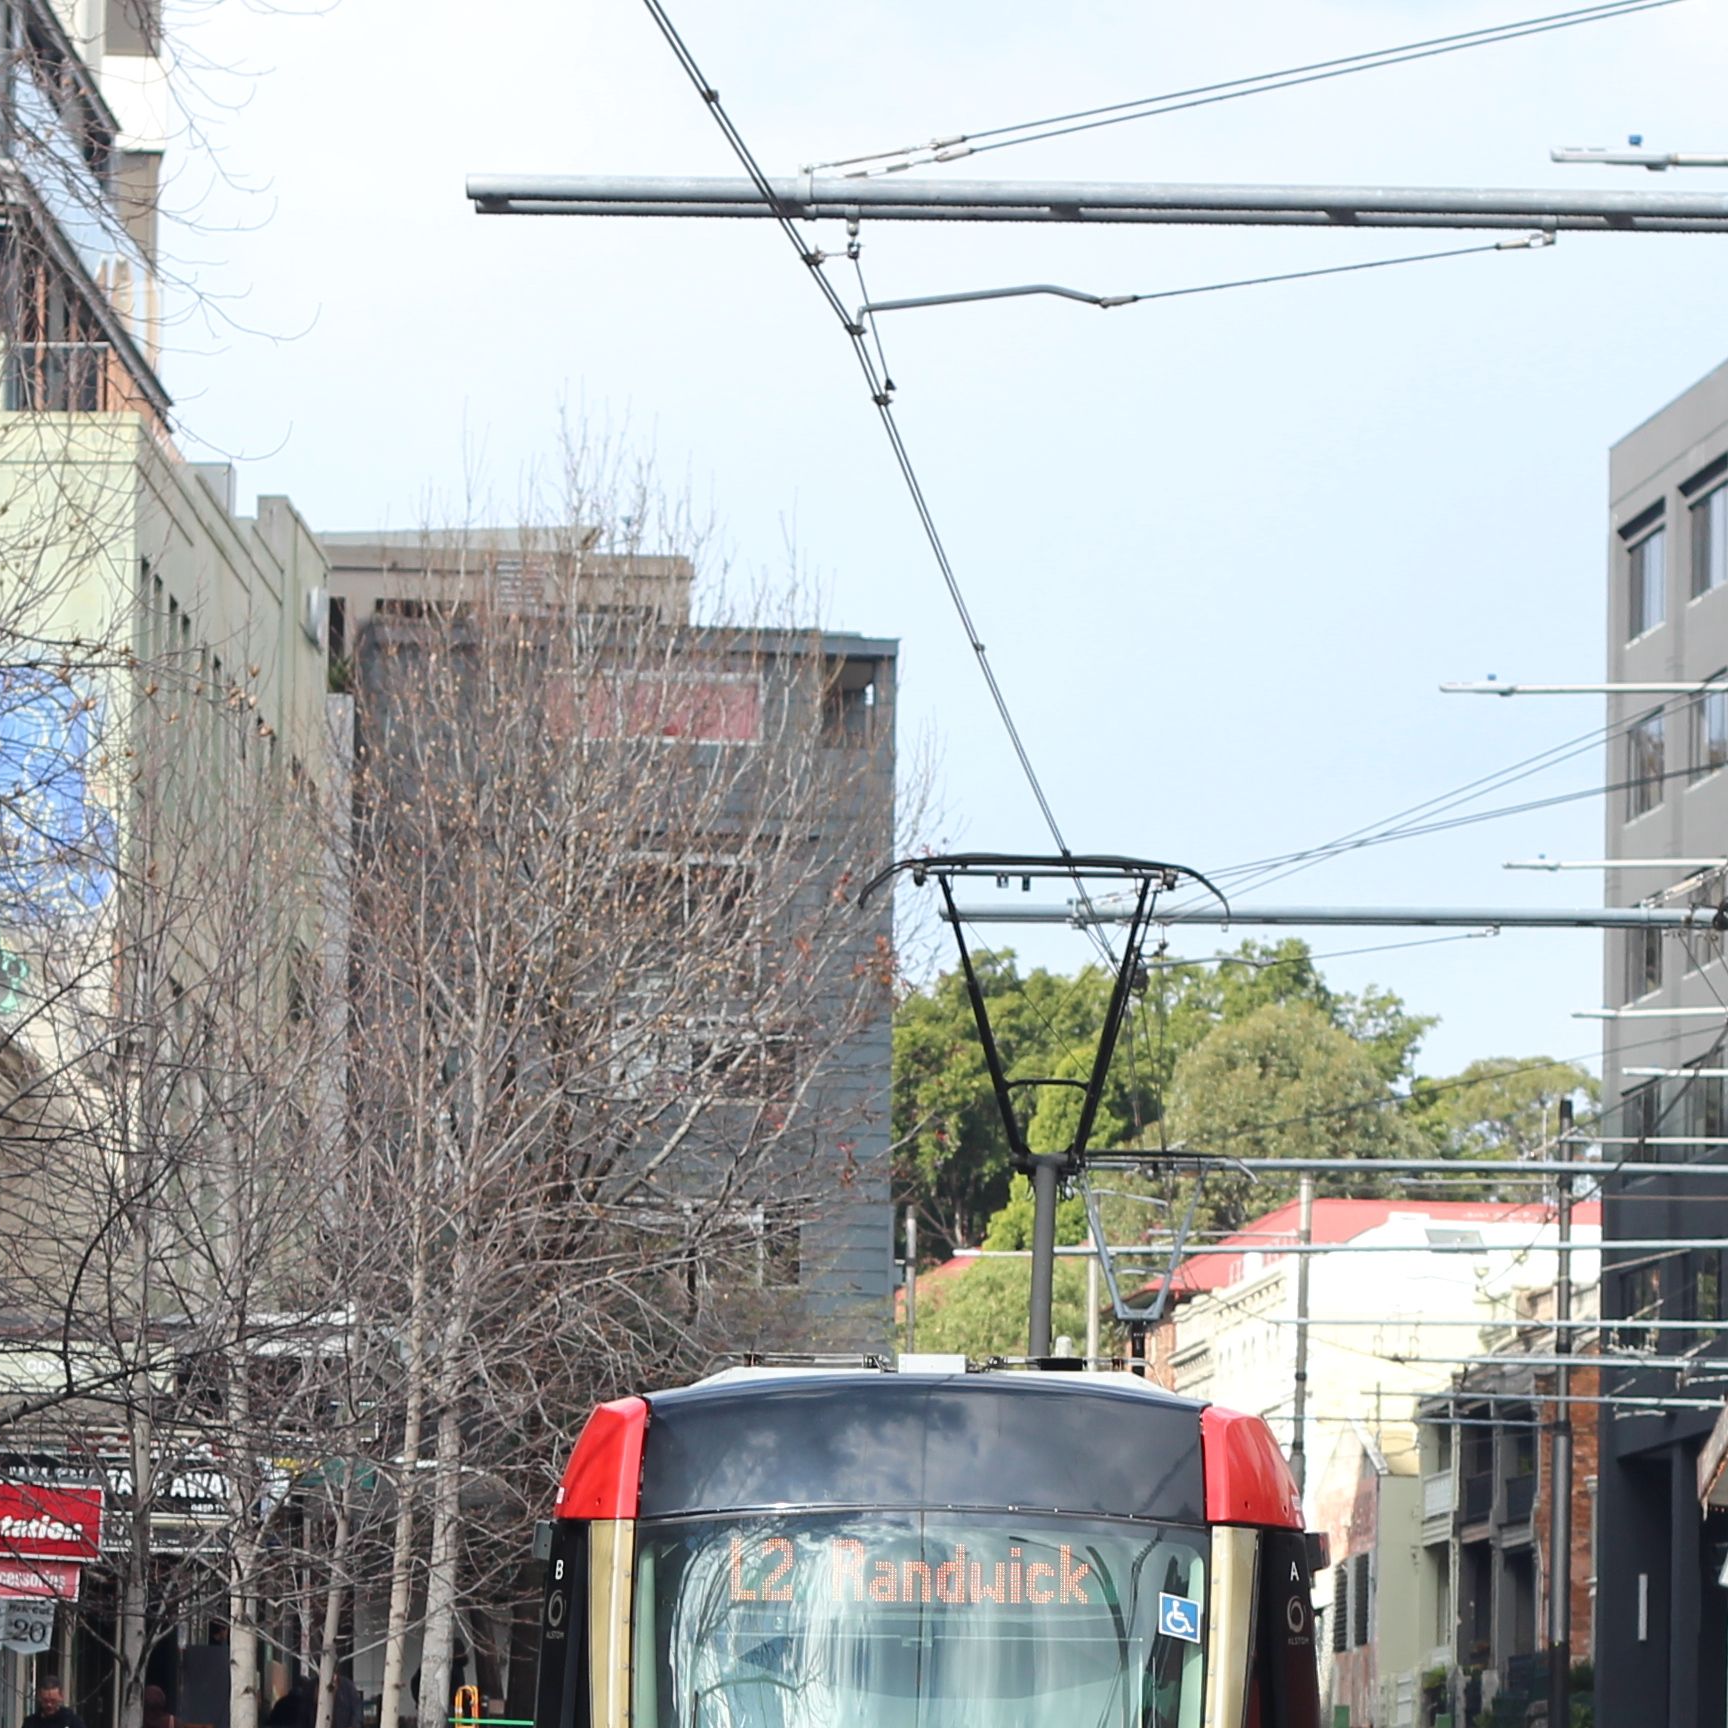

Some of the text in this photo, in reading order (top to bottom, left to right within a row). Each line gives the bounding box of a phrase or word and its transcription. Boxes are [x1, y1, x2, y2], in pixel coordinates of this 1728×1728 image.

[555, 1559, 564, 1580] B
[730, 1537, 1089, 1605] L2 Randwick
[1290, 1561, 1300, 1582] A
